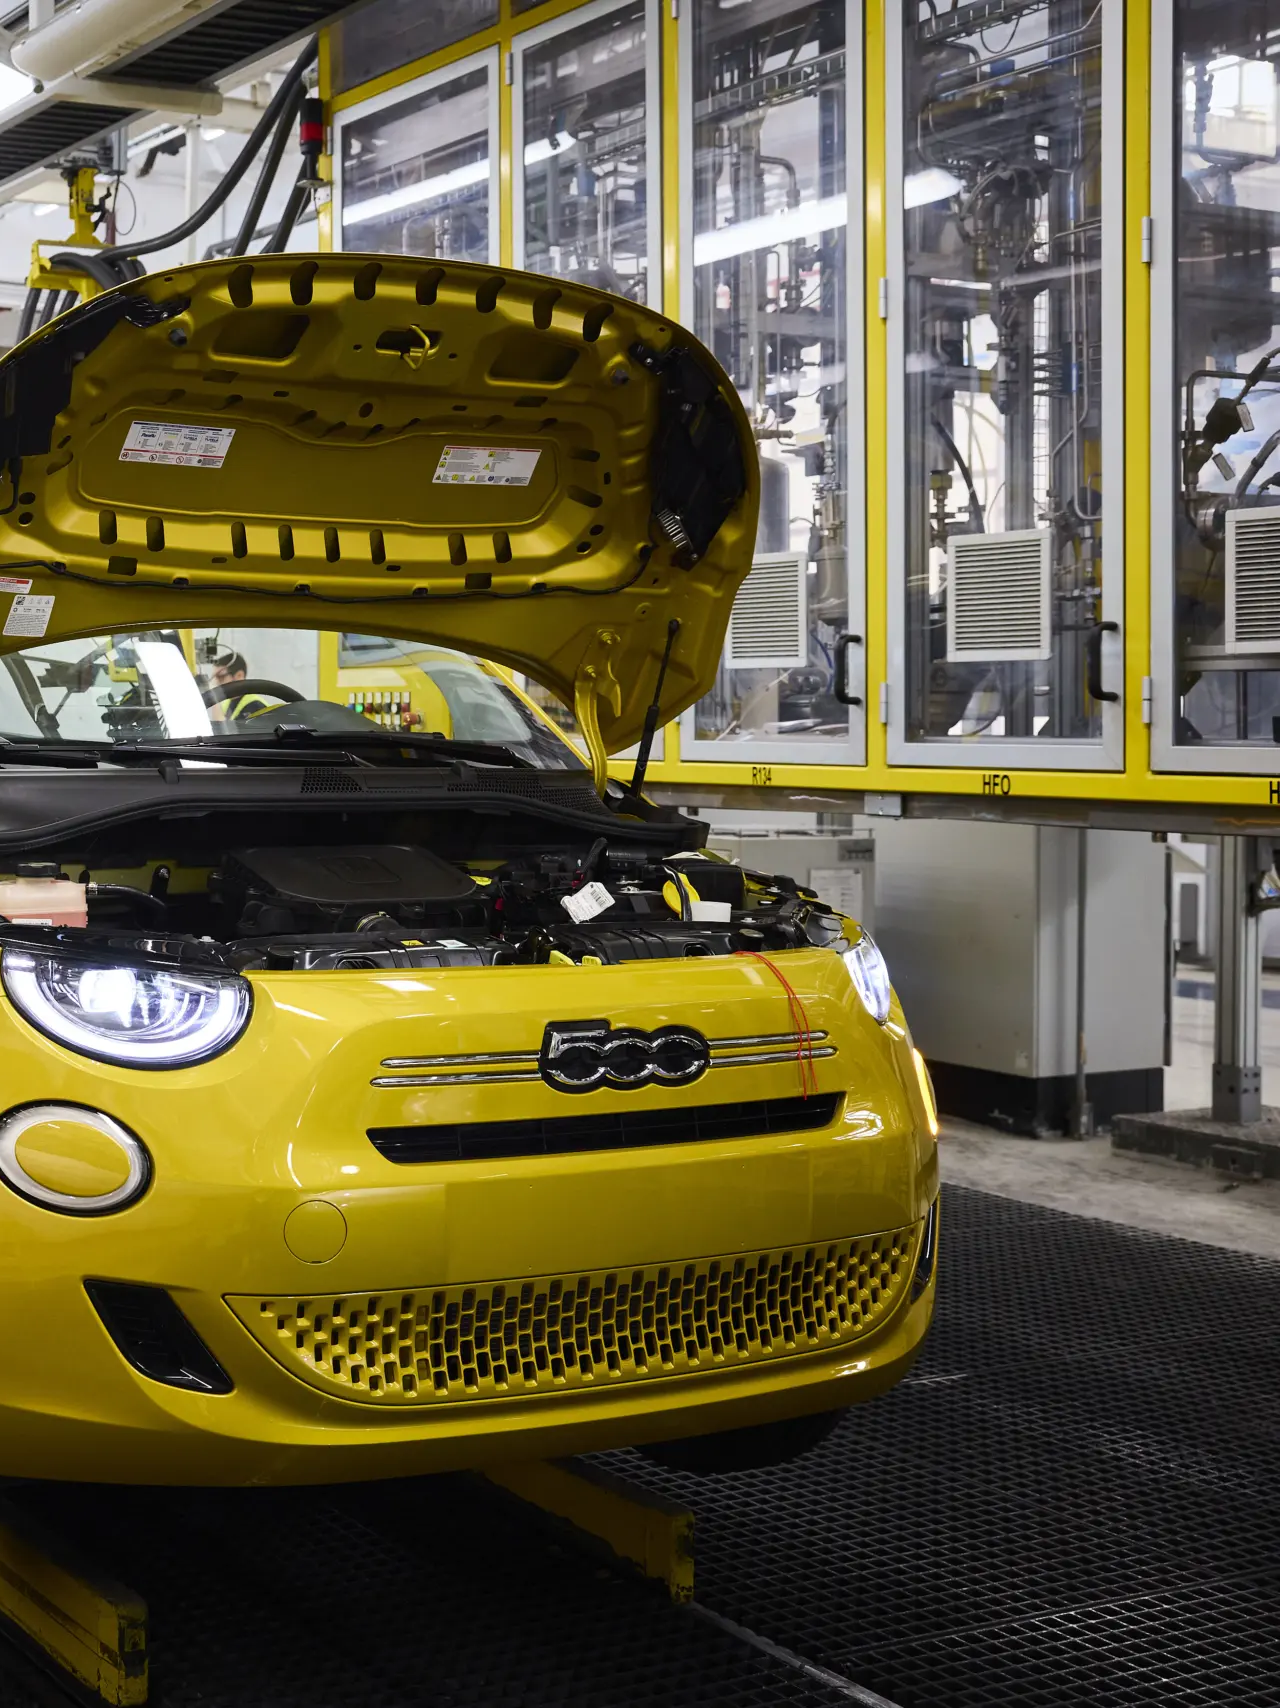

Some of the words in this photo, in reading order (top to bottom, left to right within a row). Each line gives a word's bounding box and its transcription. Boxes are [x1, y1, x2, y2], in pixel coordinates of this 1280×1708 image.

[752, 766, 772, 785] R134
[982, 774, 1011, 796] HFO
[545, 1028, 706, 1087] 500
